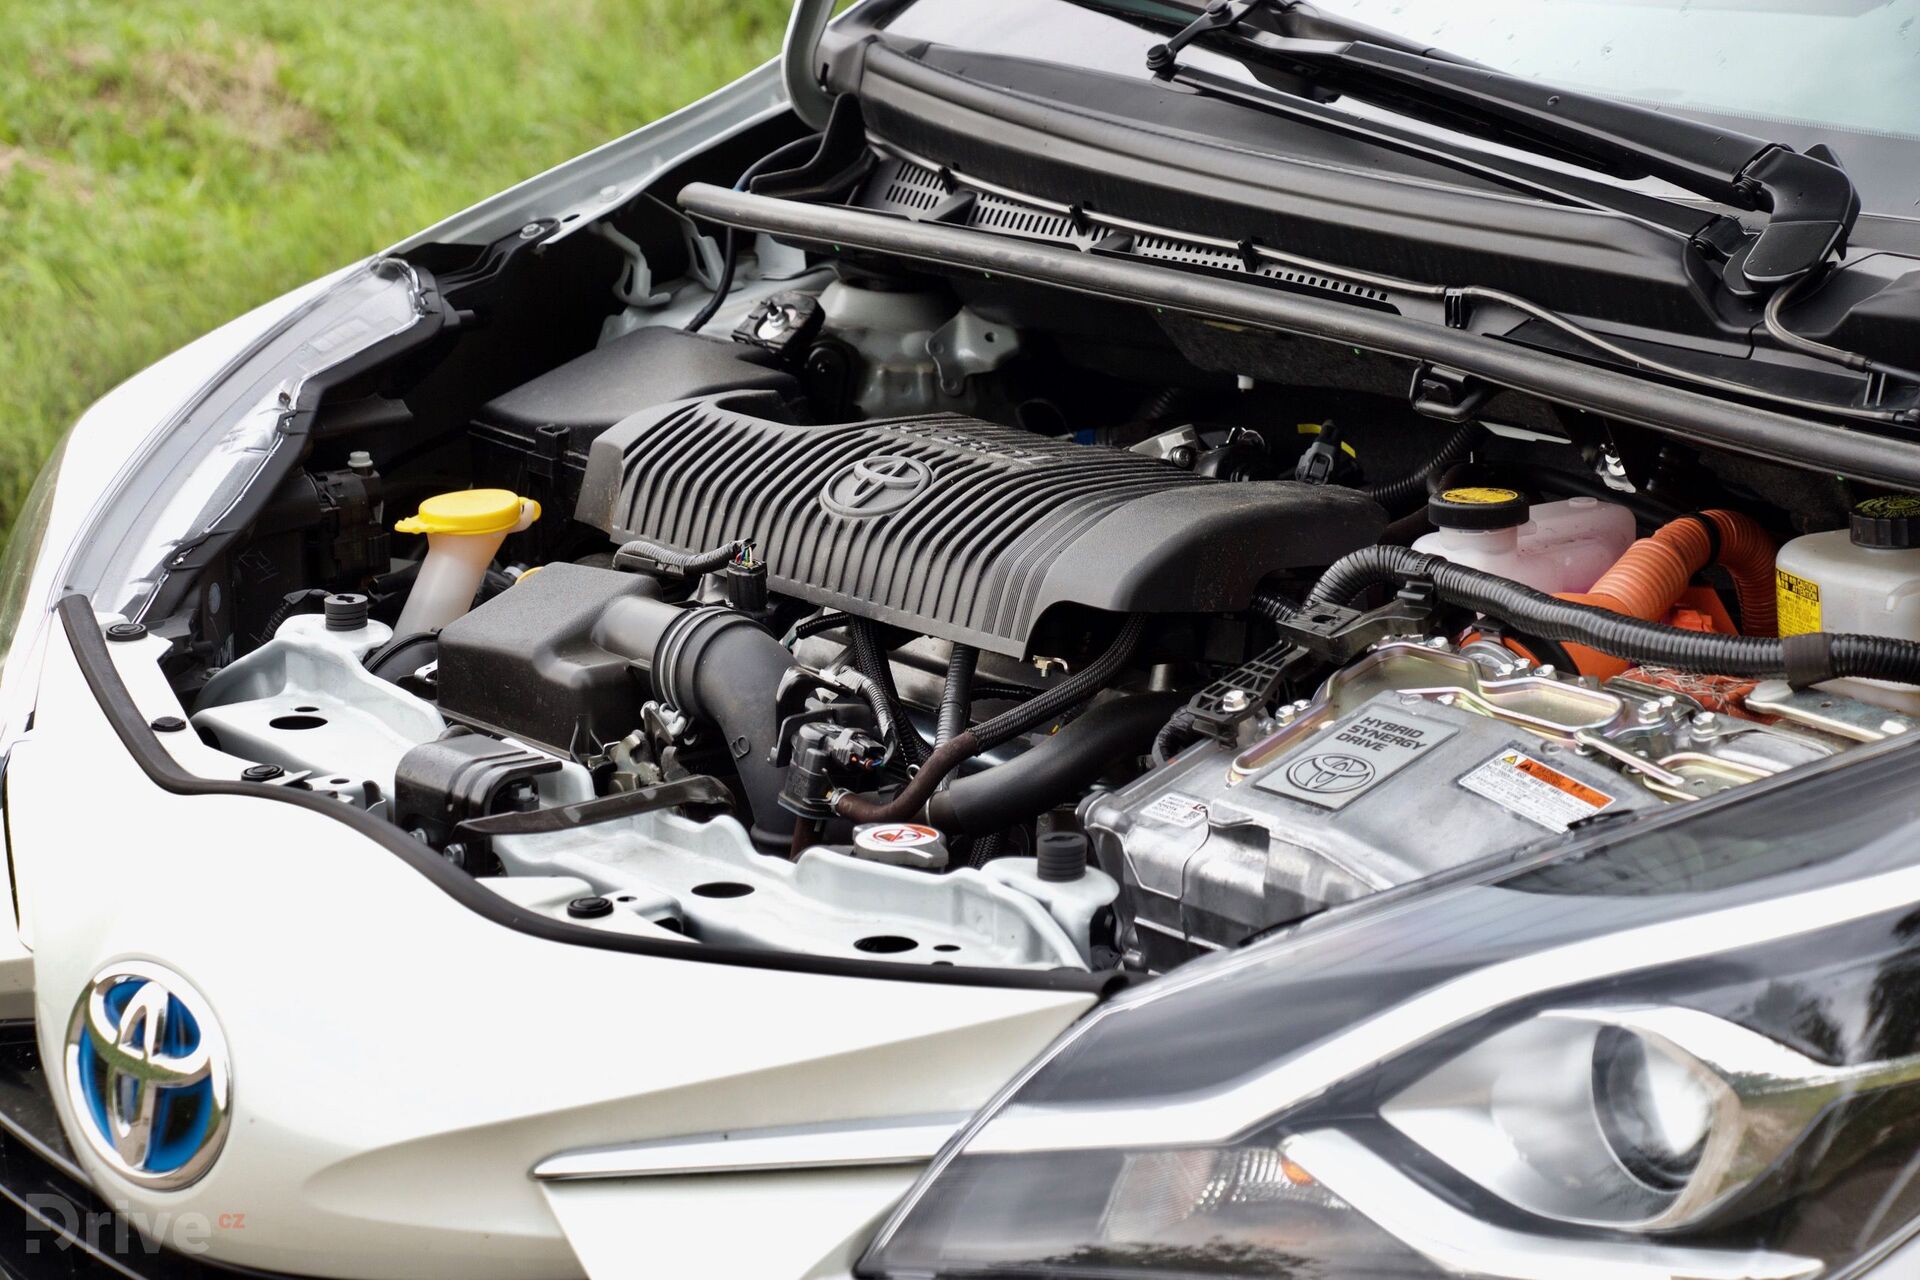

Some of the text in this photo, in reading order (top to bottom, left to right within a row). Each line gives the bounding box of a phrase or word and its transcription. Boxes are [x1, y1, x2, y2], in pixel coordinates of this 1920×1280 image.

[1348, 724, 1427, 750] SYNERGY
[1360, 717, 1424, 739] HYBRID
[1335, 732, 1388, 752] DRIVE
